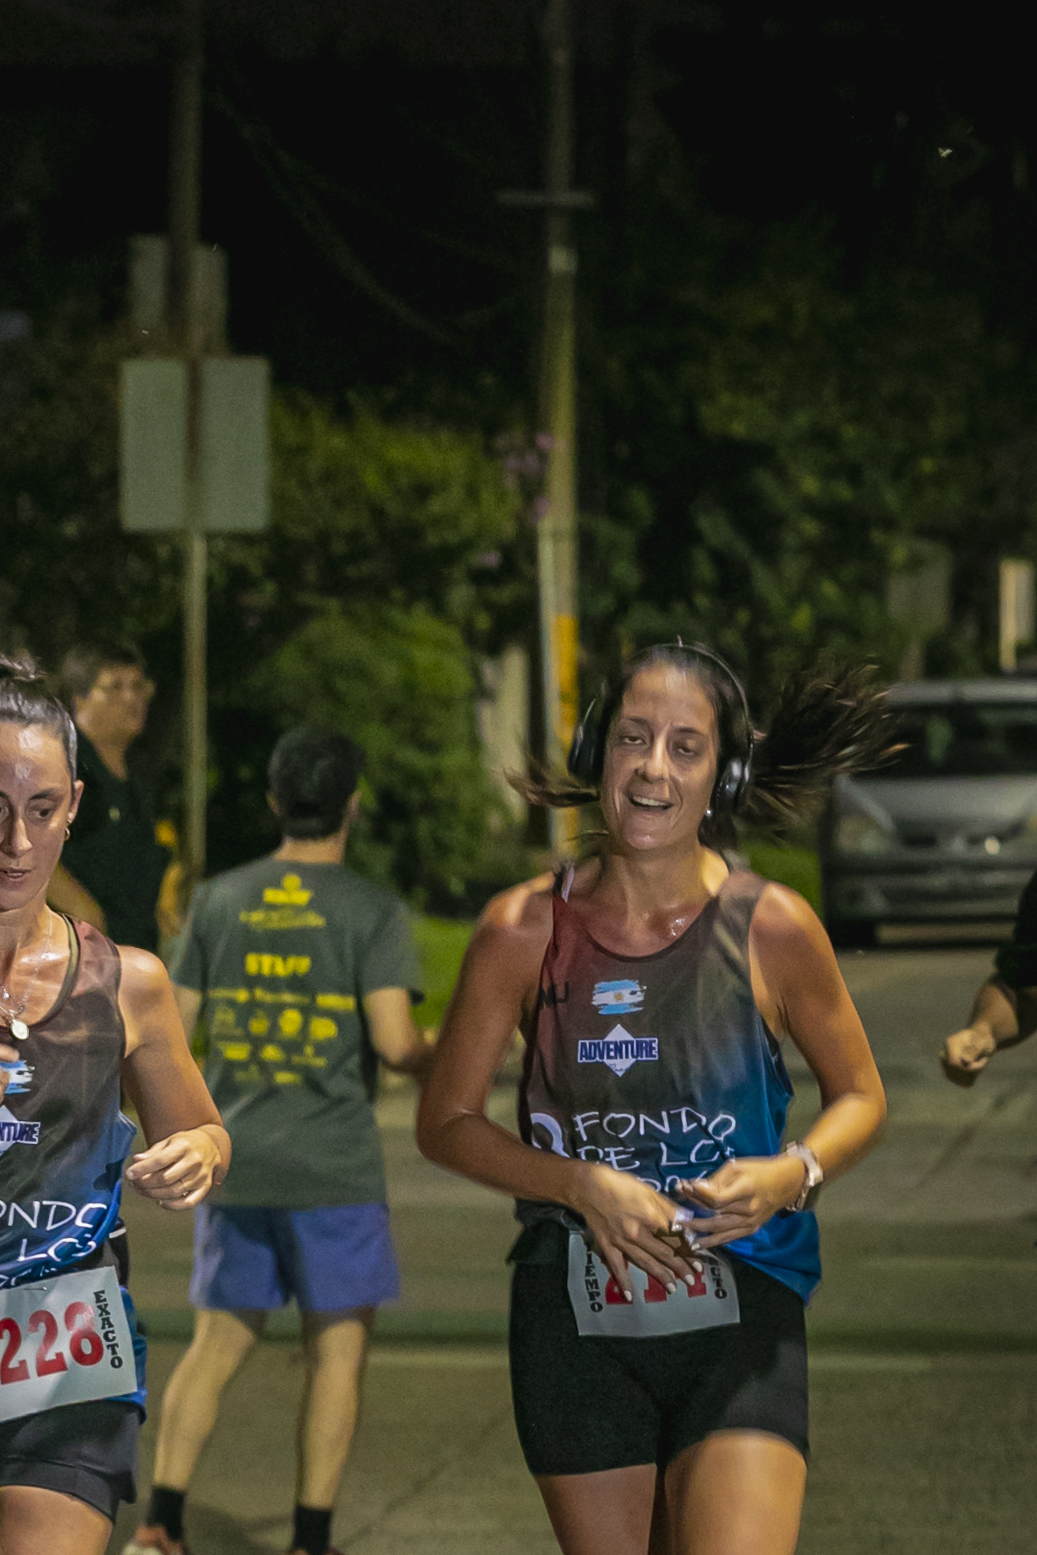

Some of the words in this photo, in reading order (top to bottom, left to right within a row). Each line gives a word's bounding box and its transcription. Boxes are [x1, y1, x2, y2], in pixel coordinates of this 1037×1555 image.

[579, 1039, 658, 1061] ADVENTURE
[573, 1107, 736, 1142] FONDO
[93, 1290, 124, 1369] EXACTO
